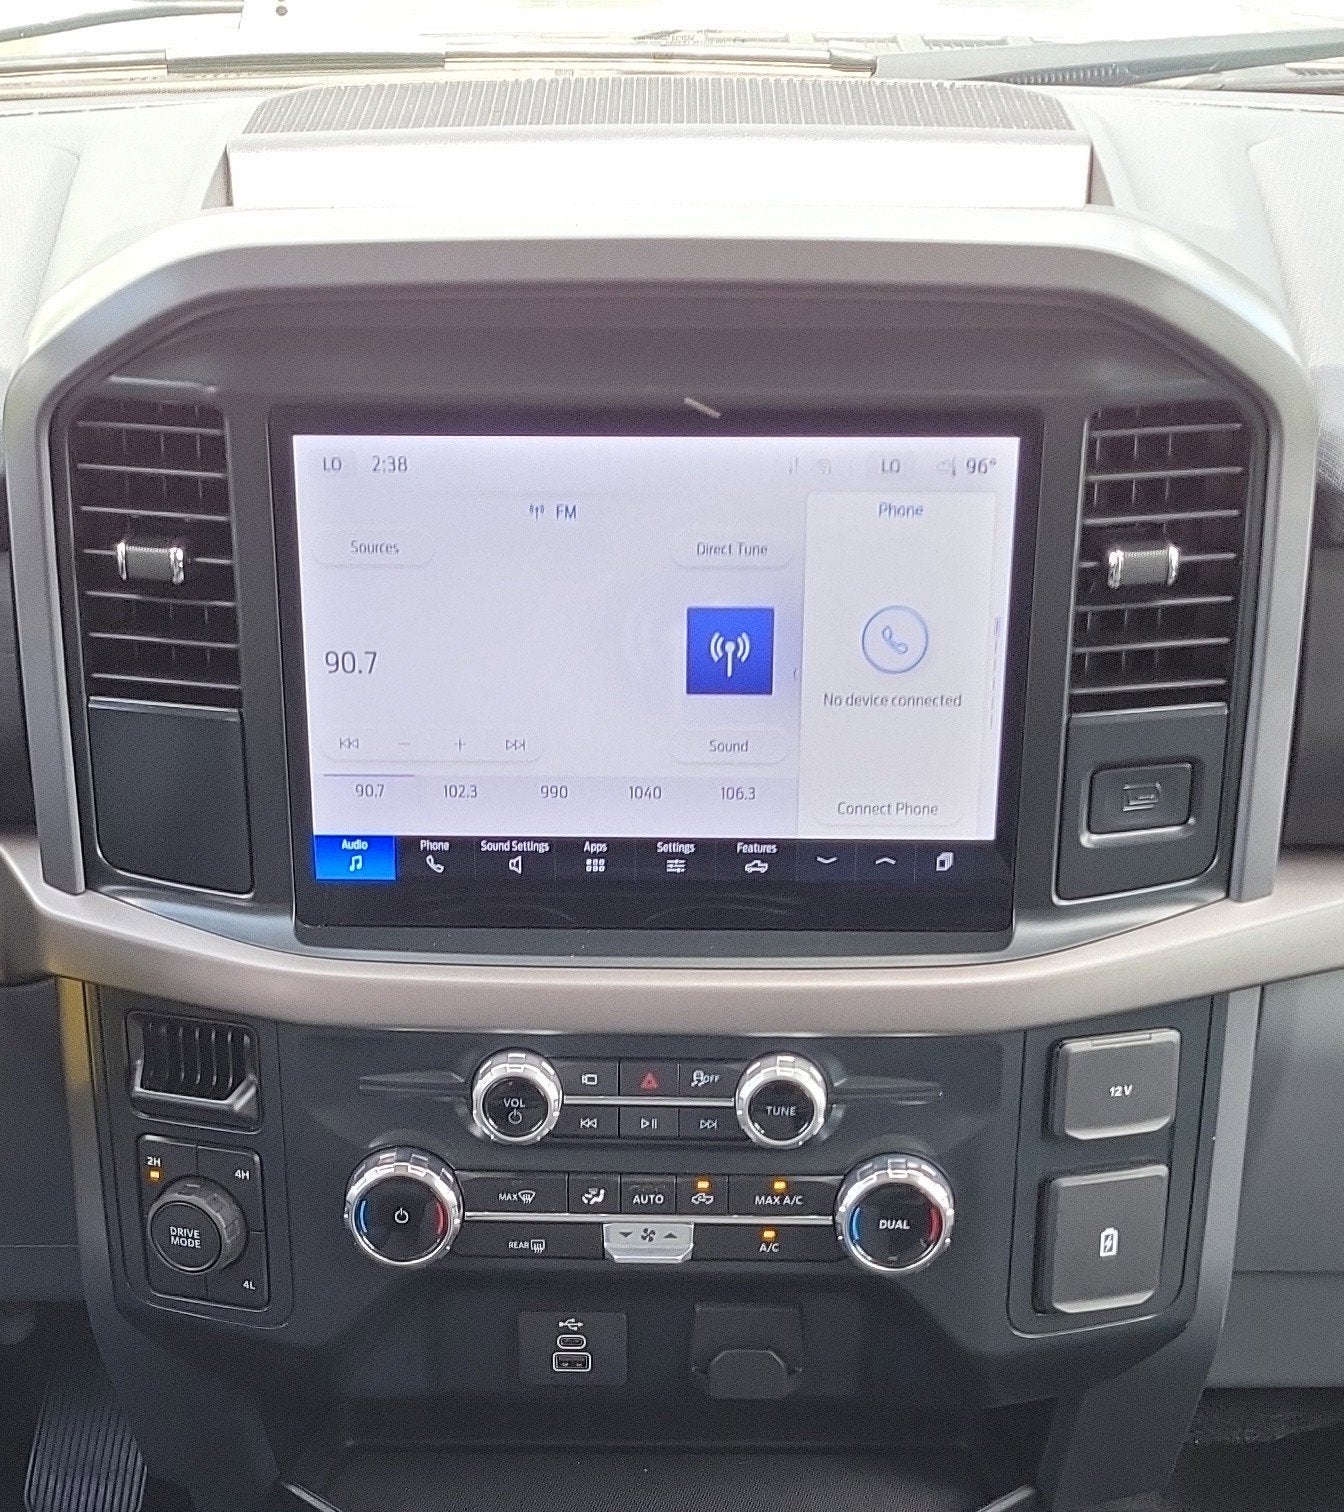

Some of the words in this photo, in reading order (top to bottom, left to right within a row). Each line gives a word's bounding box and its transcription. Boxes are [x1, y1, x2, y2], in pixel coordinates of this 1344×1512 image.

[371, 456, 408, 473] 2:38
[966, 458, 997, 475] 96°
[555, 504, 578, 520] FM
[879, 502, 924, 517] Phone
[351, 540, 400, 555] Sources
[696, 541, 732, 556] Direct
[736, 541, 768, 556] Tune
[324, 651, 378, 675] 90.7
[823, 693, 843, 708] No
[845, 693, 888, 708] device
[891, 693, 962, 708] connected
[709, 739, 749, 753] Sound
[354, 784, 385, 799] 90.7
[443, 784, 478, 799] 102.3
[540, 785, 568, 800] 990
[629, 786, 662, 800] 1040
[720, 786, 756, 801] 106.3
[837, 801, 892, 816] Connect
[896, 801, 938, 816] Phone
[341, 838, 368, 851] Audio
[420, 839, 449, 852] Phone
[480, 840, 508, 852] Sound
[511, 840, 549, 853] Settings
[583, 841, 607, 854] Apps
[656, 842, 695, 855] Settings
[736, 842, 777, 854] Features
[703, 1074, 720, 1084] OFF
[503, 1098, 525, 1109] VOL
[765, 1105, 796, 1117] TUNE
[147, 1156, 161, 1167] 2H
[234, 1169, 250, 1181] 4H
[498, 1193, 518, 1202] MAX
[632, 1194, 665, 1205] AUTO
[755, 1195, 781, 1206] MAX
[782, 1195, 803, 1206] A/C
[878, 1219, 911, 1230] DUAL
[169, 1226, 200, 1239] DRIVE
[170, 1235, 201, 1249] MODE
[508, 1241, 529, 1249] REAR
[759, 1242, 780, 1253] A/C
[242, 1280, 256, 1291] 4L
